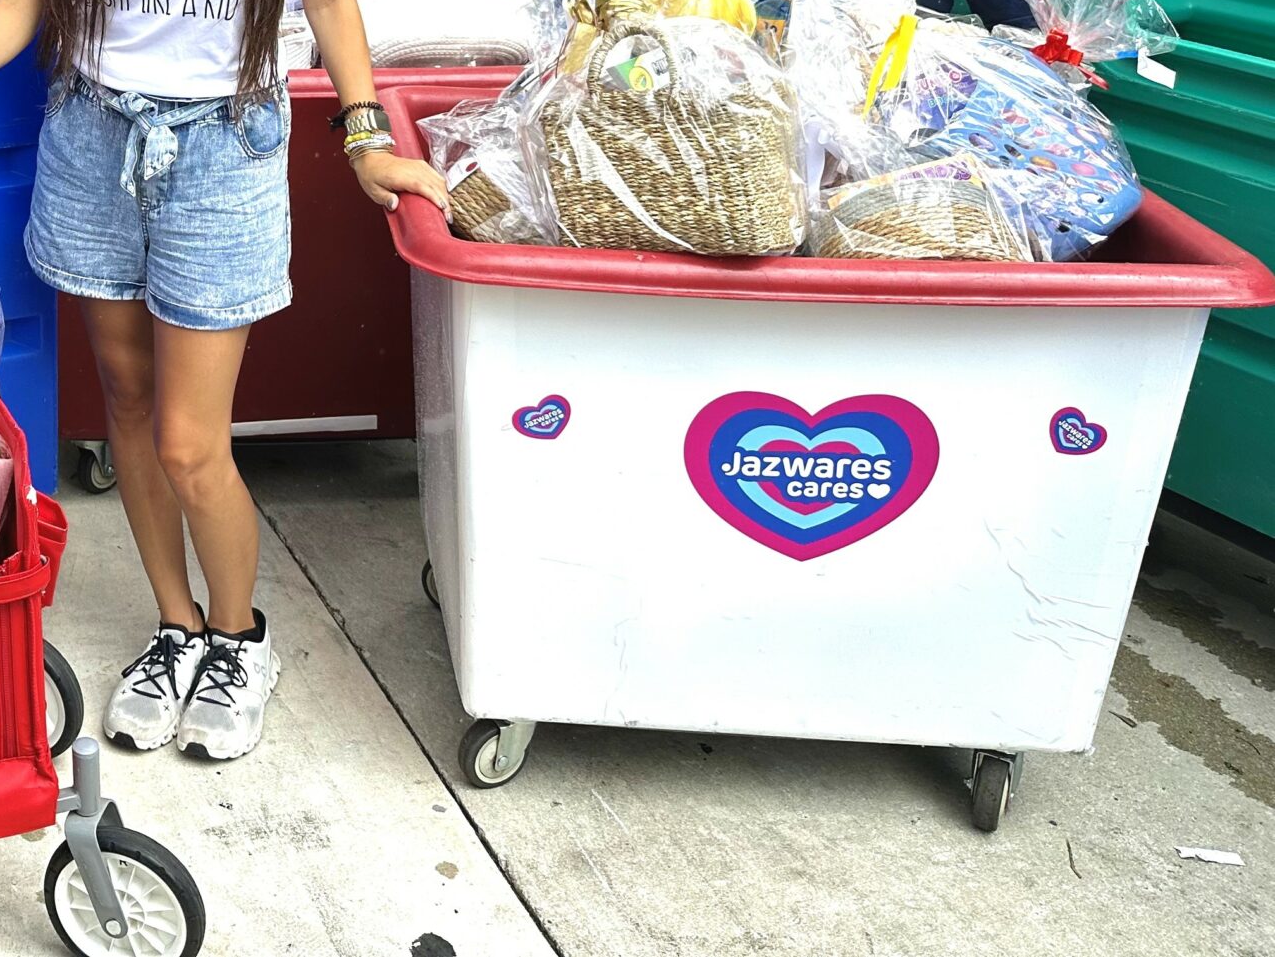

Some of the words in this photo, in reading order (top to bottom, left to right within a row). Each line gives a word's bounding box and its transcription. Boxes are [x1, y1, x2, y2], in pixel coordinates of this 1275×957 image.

[524, 408, 563, 429] Jazwares
[1058, 420, 1093, 446] Jazwares
[721, 451, 892, 480] Jazwares
[786, 480, 864, 499] cares
